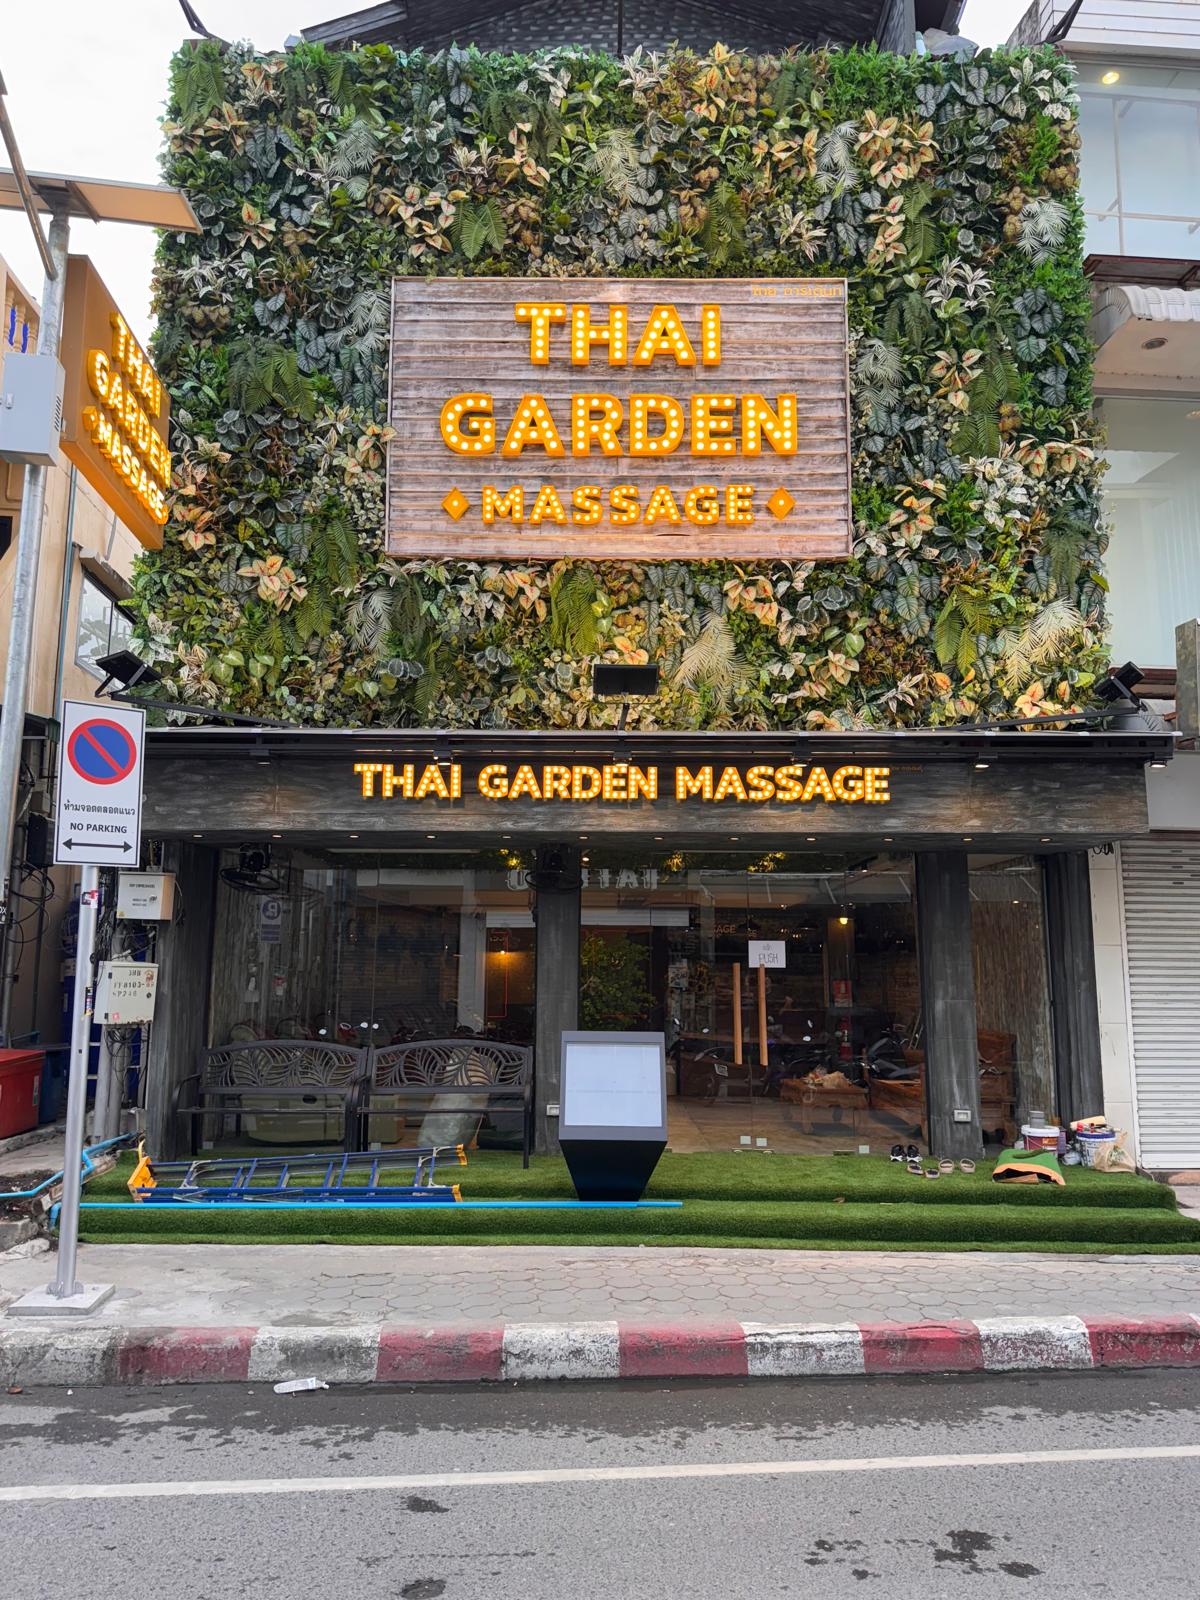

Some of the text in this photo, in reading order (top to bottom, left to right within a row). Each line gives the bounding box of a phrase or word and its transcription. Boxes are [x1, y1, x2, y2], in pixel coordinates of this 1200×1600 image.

[515, 303, 722, 366] THAI
[110, 311, 161, 419] THAI
[88, 349, 171, 488] GARDEN
[440, 392, 798, 456] GARDEN
[92, 412, 165, 522] MASSAGE
[482, 484, 755, 525] MASSAGE
[64, 799, 136, 816] ห้ามจอดตลอดแนว
[353, 763, 891, 801] THAI GARDEN MASSAGE
[70, 822, 128, 834] NO PARKING
[758, 952, 779, 965] PUSH
